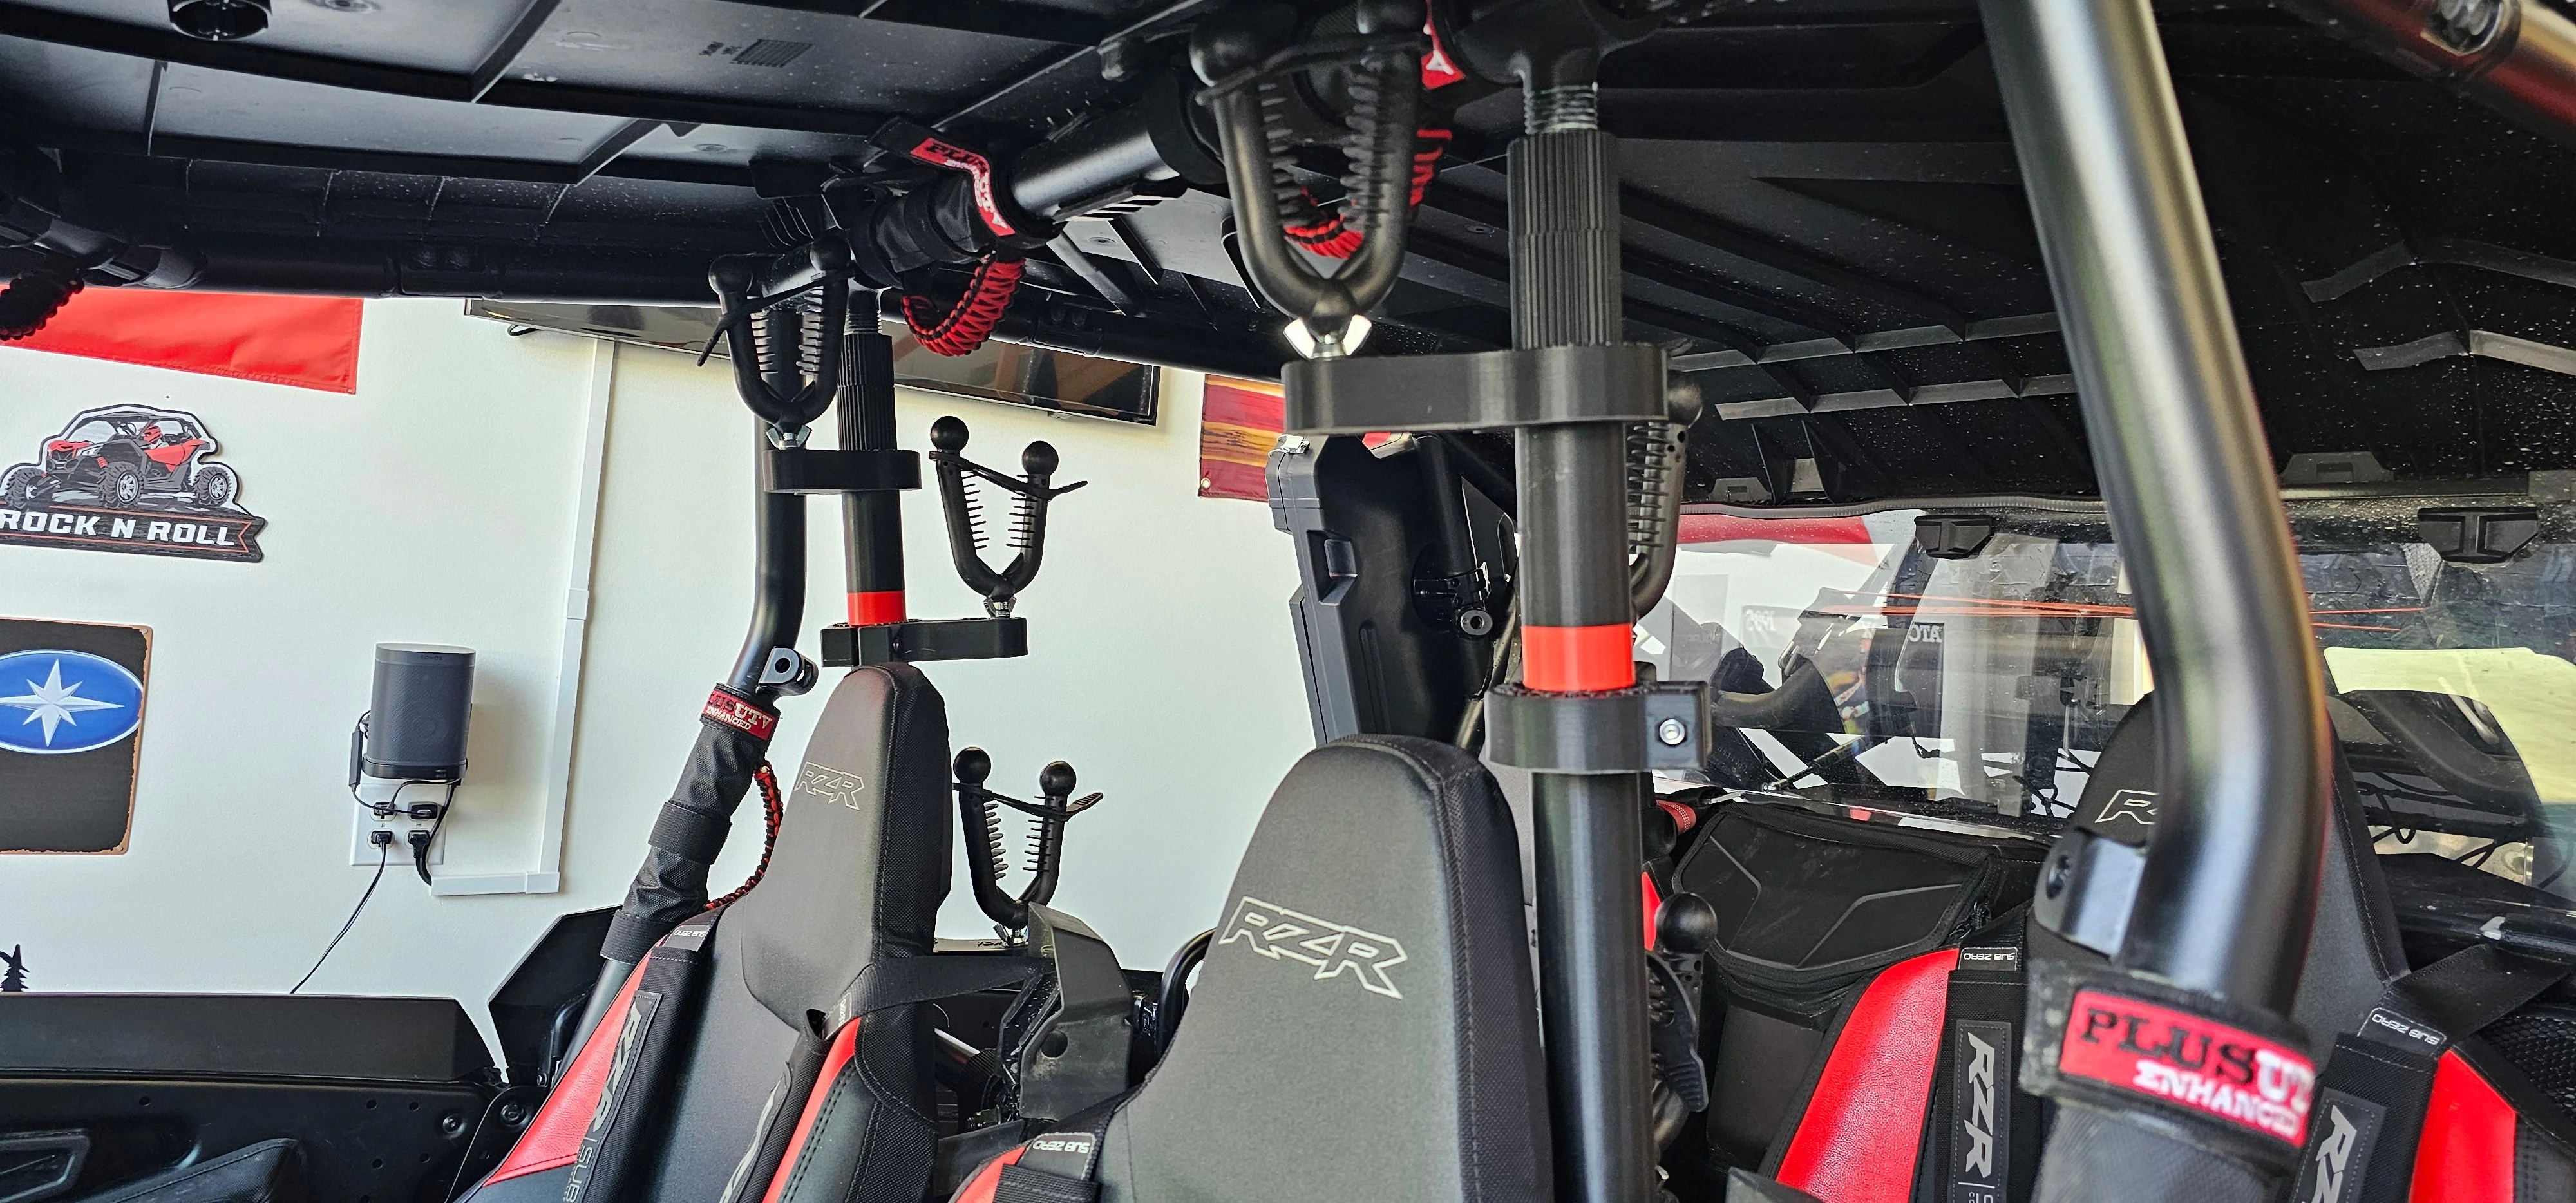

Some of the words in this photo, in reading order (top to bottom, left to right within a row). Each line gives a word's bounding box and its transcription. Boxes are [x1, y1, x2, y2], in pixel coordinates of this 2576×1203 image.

[0, 509, 100, 536] ROCK
[111, 518, 136, 538] N
[147, 521, 235, 546] ROLL
[793, 761, 865, 811] RZR
[1218, 896, 1408, 1000] RZR
[1993, 952, 2016, 961] SUB
[2372, 1013, 2410, 1034] ZERO
[2408, 1028, 2440, 1045] SUB
[591, 1001, 643, 1132] RZR
[1964, 1032, 1994, 1179] RZR
[1032, 1140, 1066, 1151] ZERO
[1064, 1141, 1091, 1154] SUB
[566, 1145, 594, 1202] SUB
